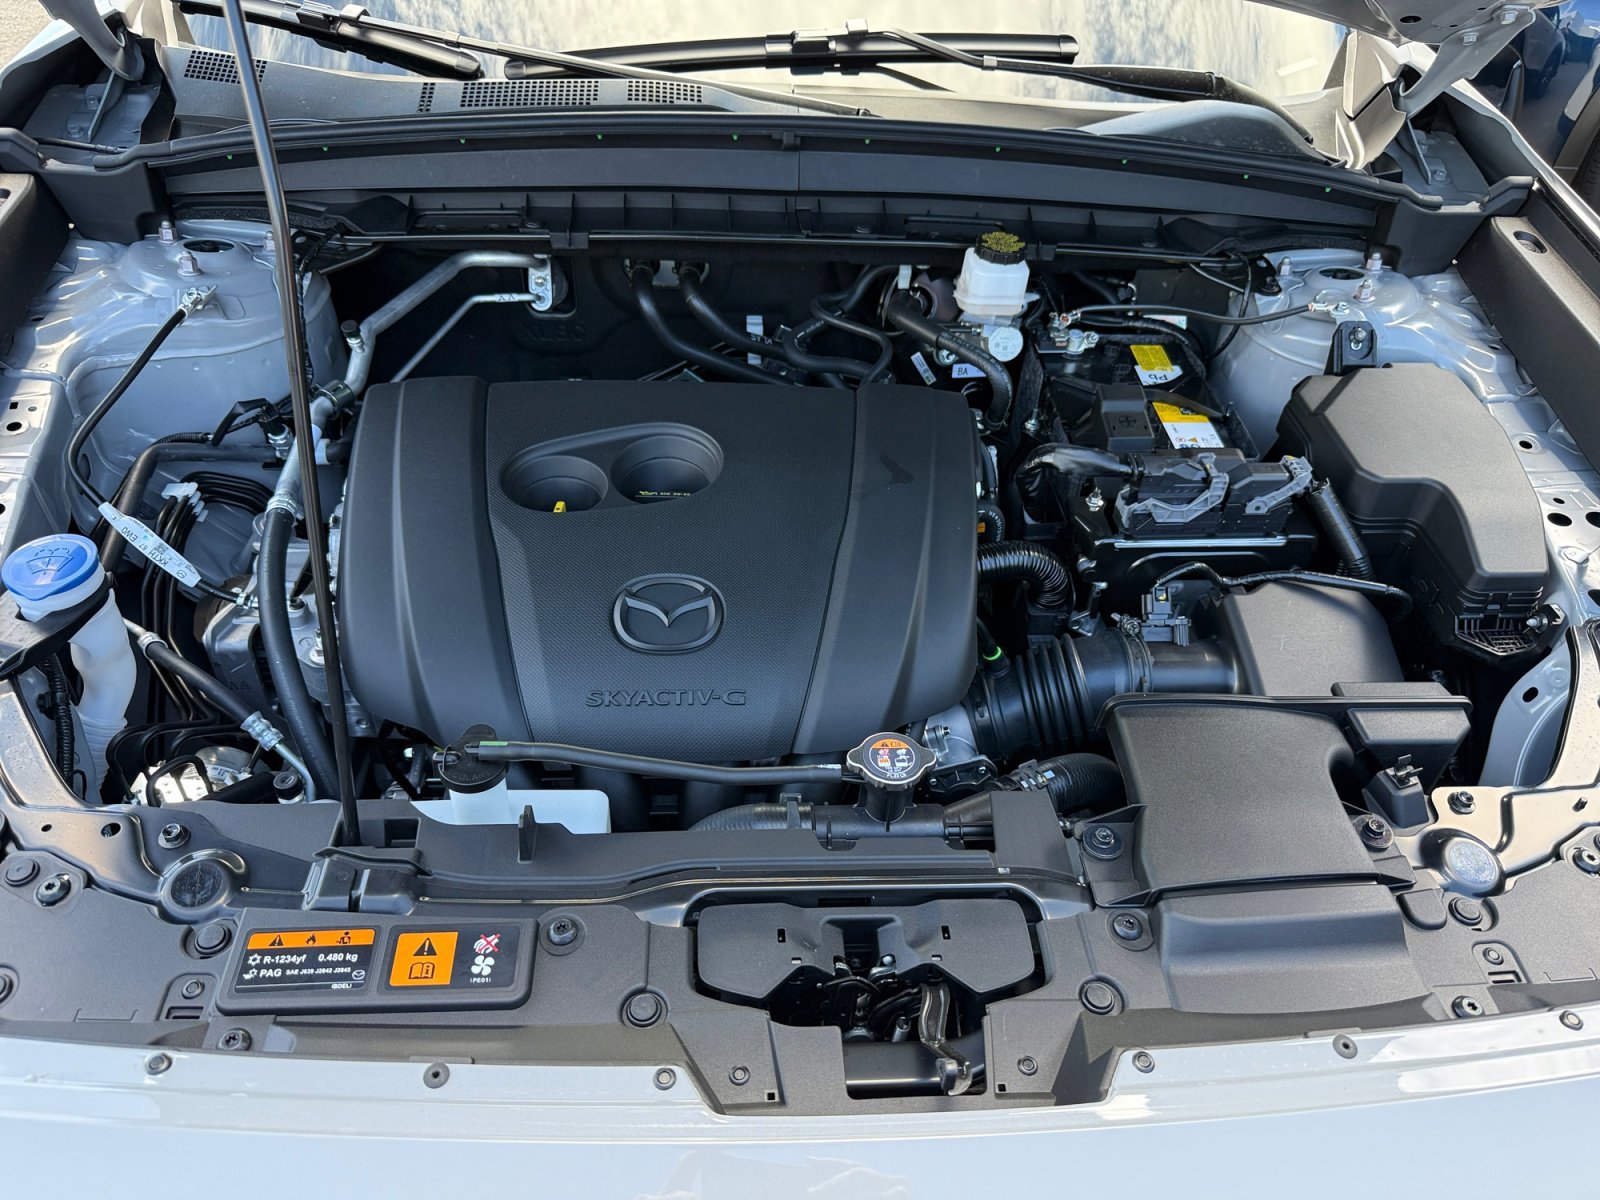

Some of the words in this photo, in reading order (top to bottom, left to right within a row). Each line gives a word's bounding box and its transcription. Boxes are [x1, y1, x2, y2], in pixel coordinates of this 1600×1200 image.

[1148, 373, 1168, 381] Pb
[584, 689, 747, 707] SKYACTIV-G
[263, 953, 307, 965] R-1234yf
[317, 953, 344, 963] 0.480
[345, 952, 359, 963] kg
[259, 968, 282, 978] PAG
